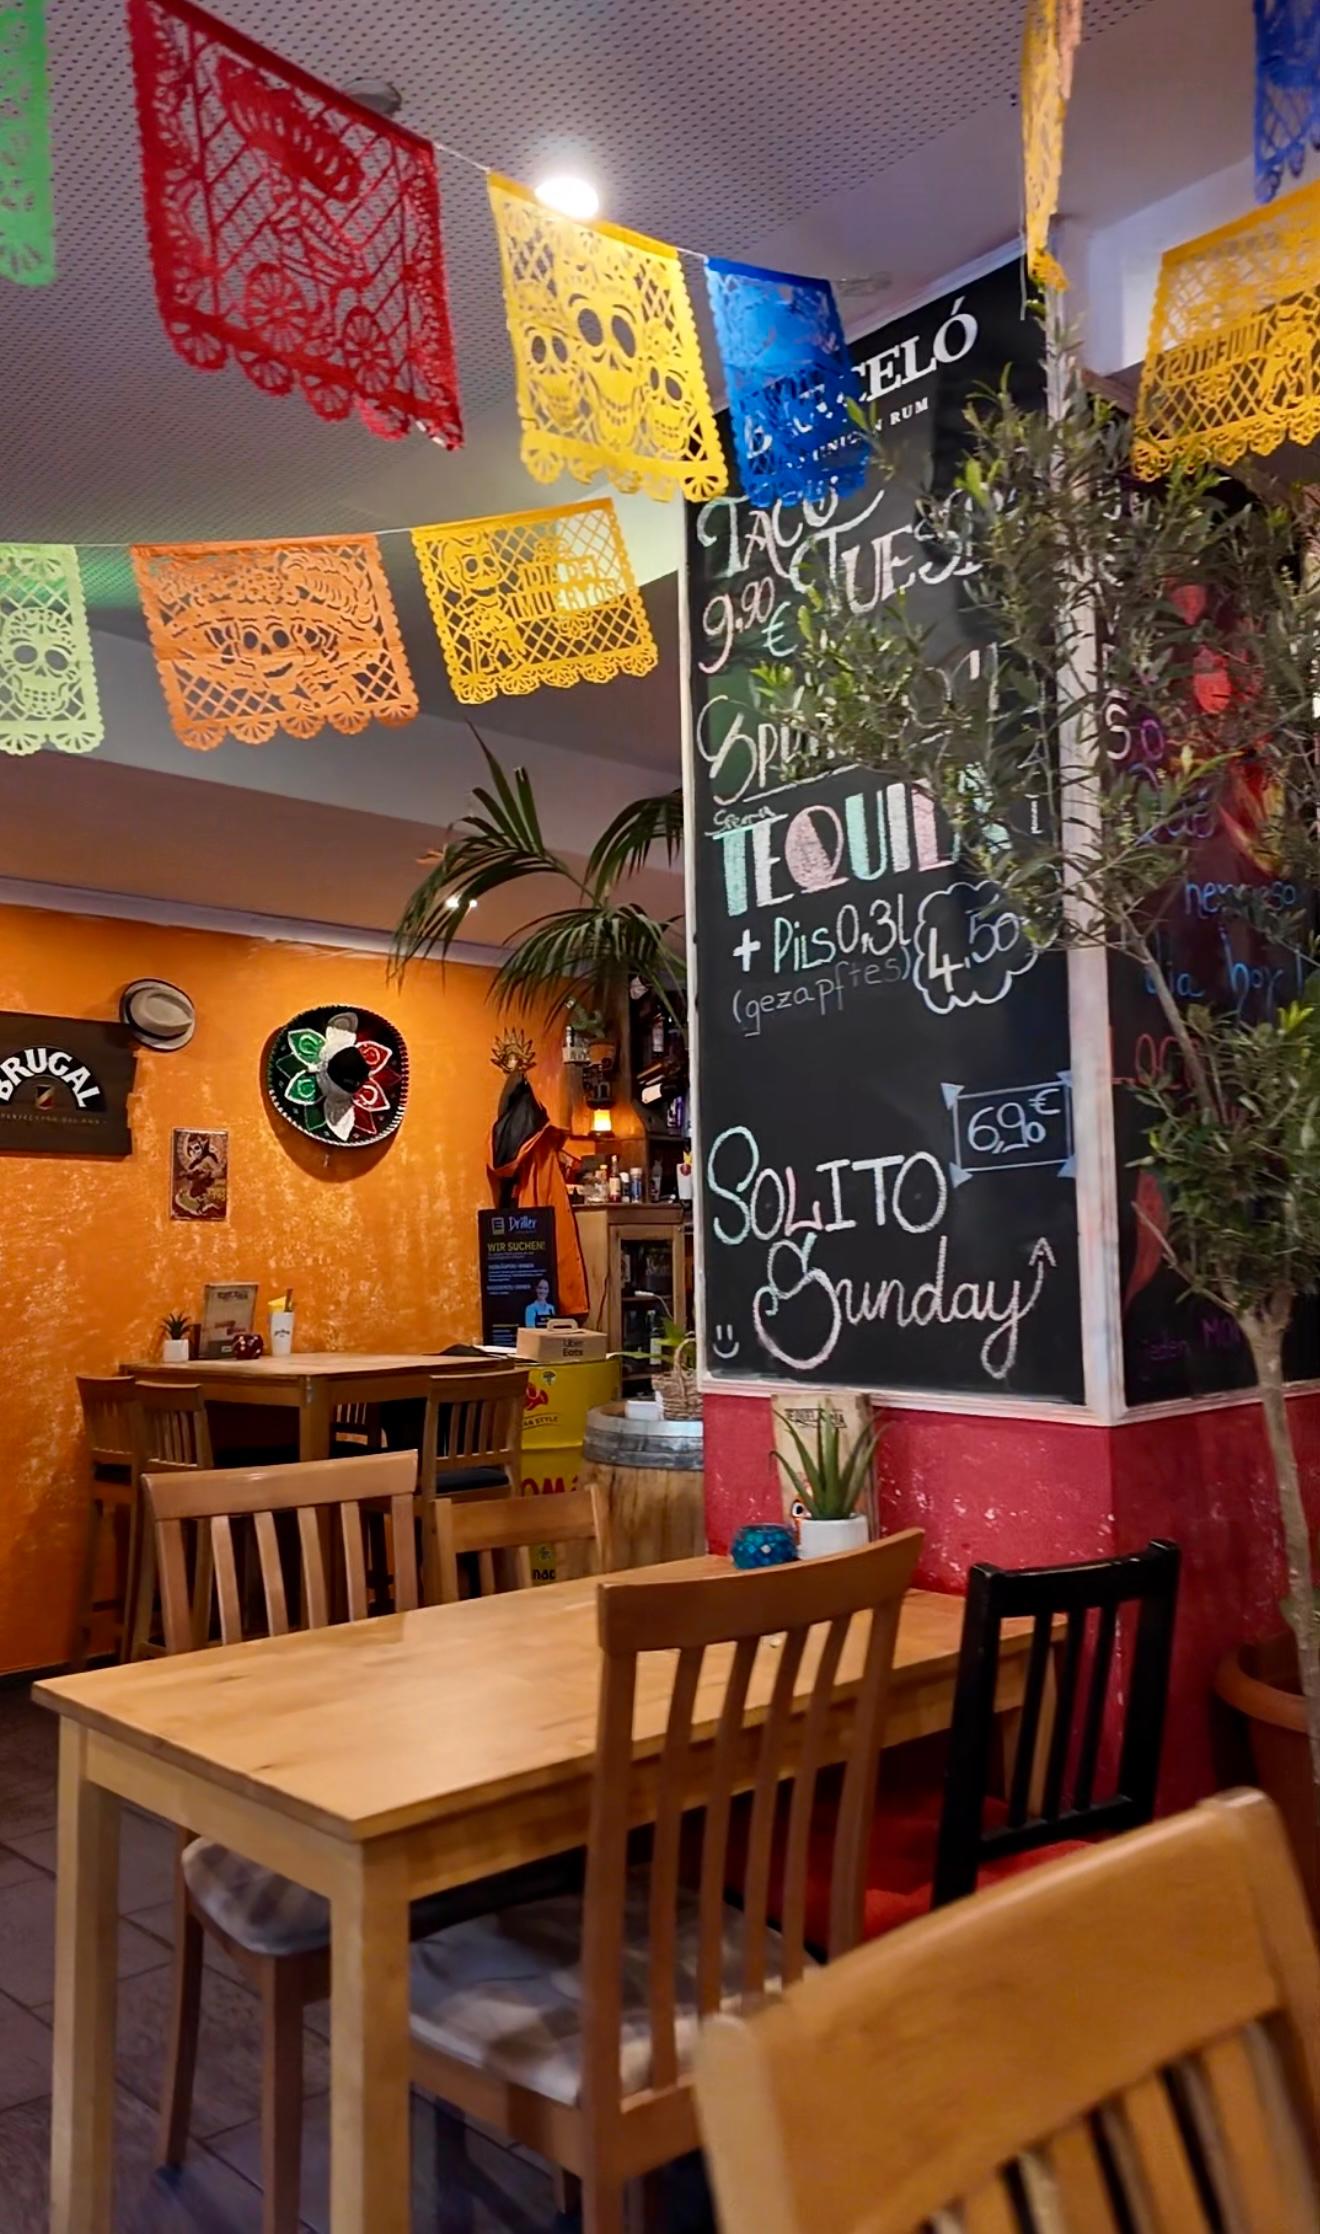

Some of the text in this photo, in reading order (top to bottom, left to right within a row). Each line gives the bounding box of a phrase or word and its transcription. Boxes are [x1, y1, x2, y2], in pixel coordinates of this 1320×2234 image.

[890, 397, 929, 426] RUM
[0, 1047, 101, 1108] BRUGAL
[707, 1125, 947, 1245] SOLITO
[487, 1241, 506, 1252] WIR
[753, 1232, 1041, 1380] Sunday
